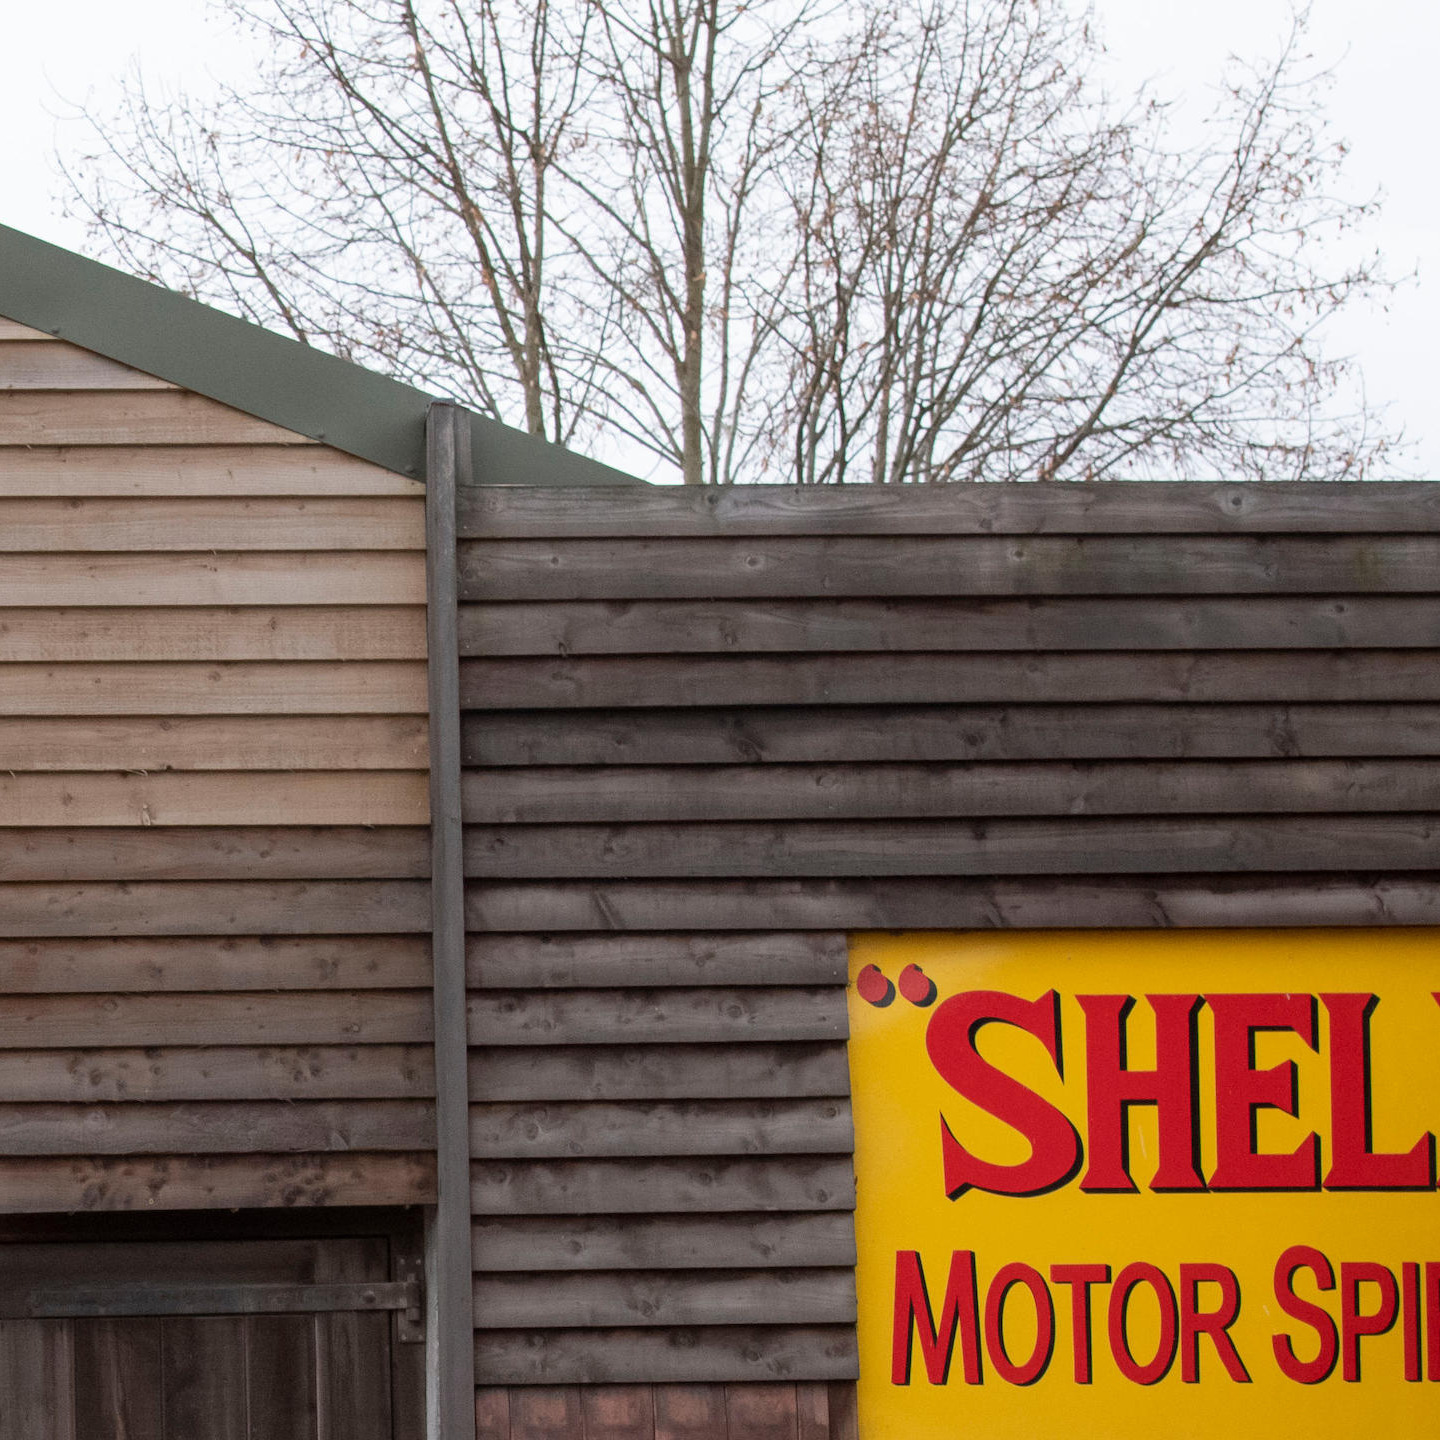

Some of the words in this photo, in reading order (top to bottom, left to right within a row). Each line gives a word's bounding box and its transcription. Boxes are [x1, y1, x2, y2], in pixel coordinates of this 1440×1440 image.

[857, 963, 1440, 1202] “SHEL
[891, 1249, 1252, 1387] MOTOR
[1271, 1244, 1440, 1386] SPI
